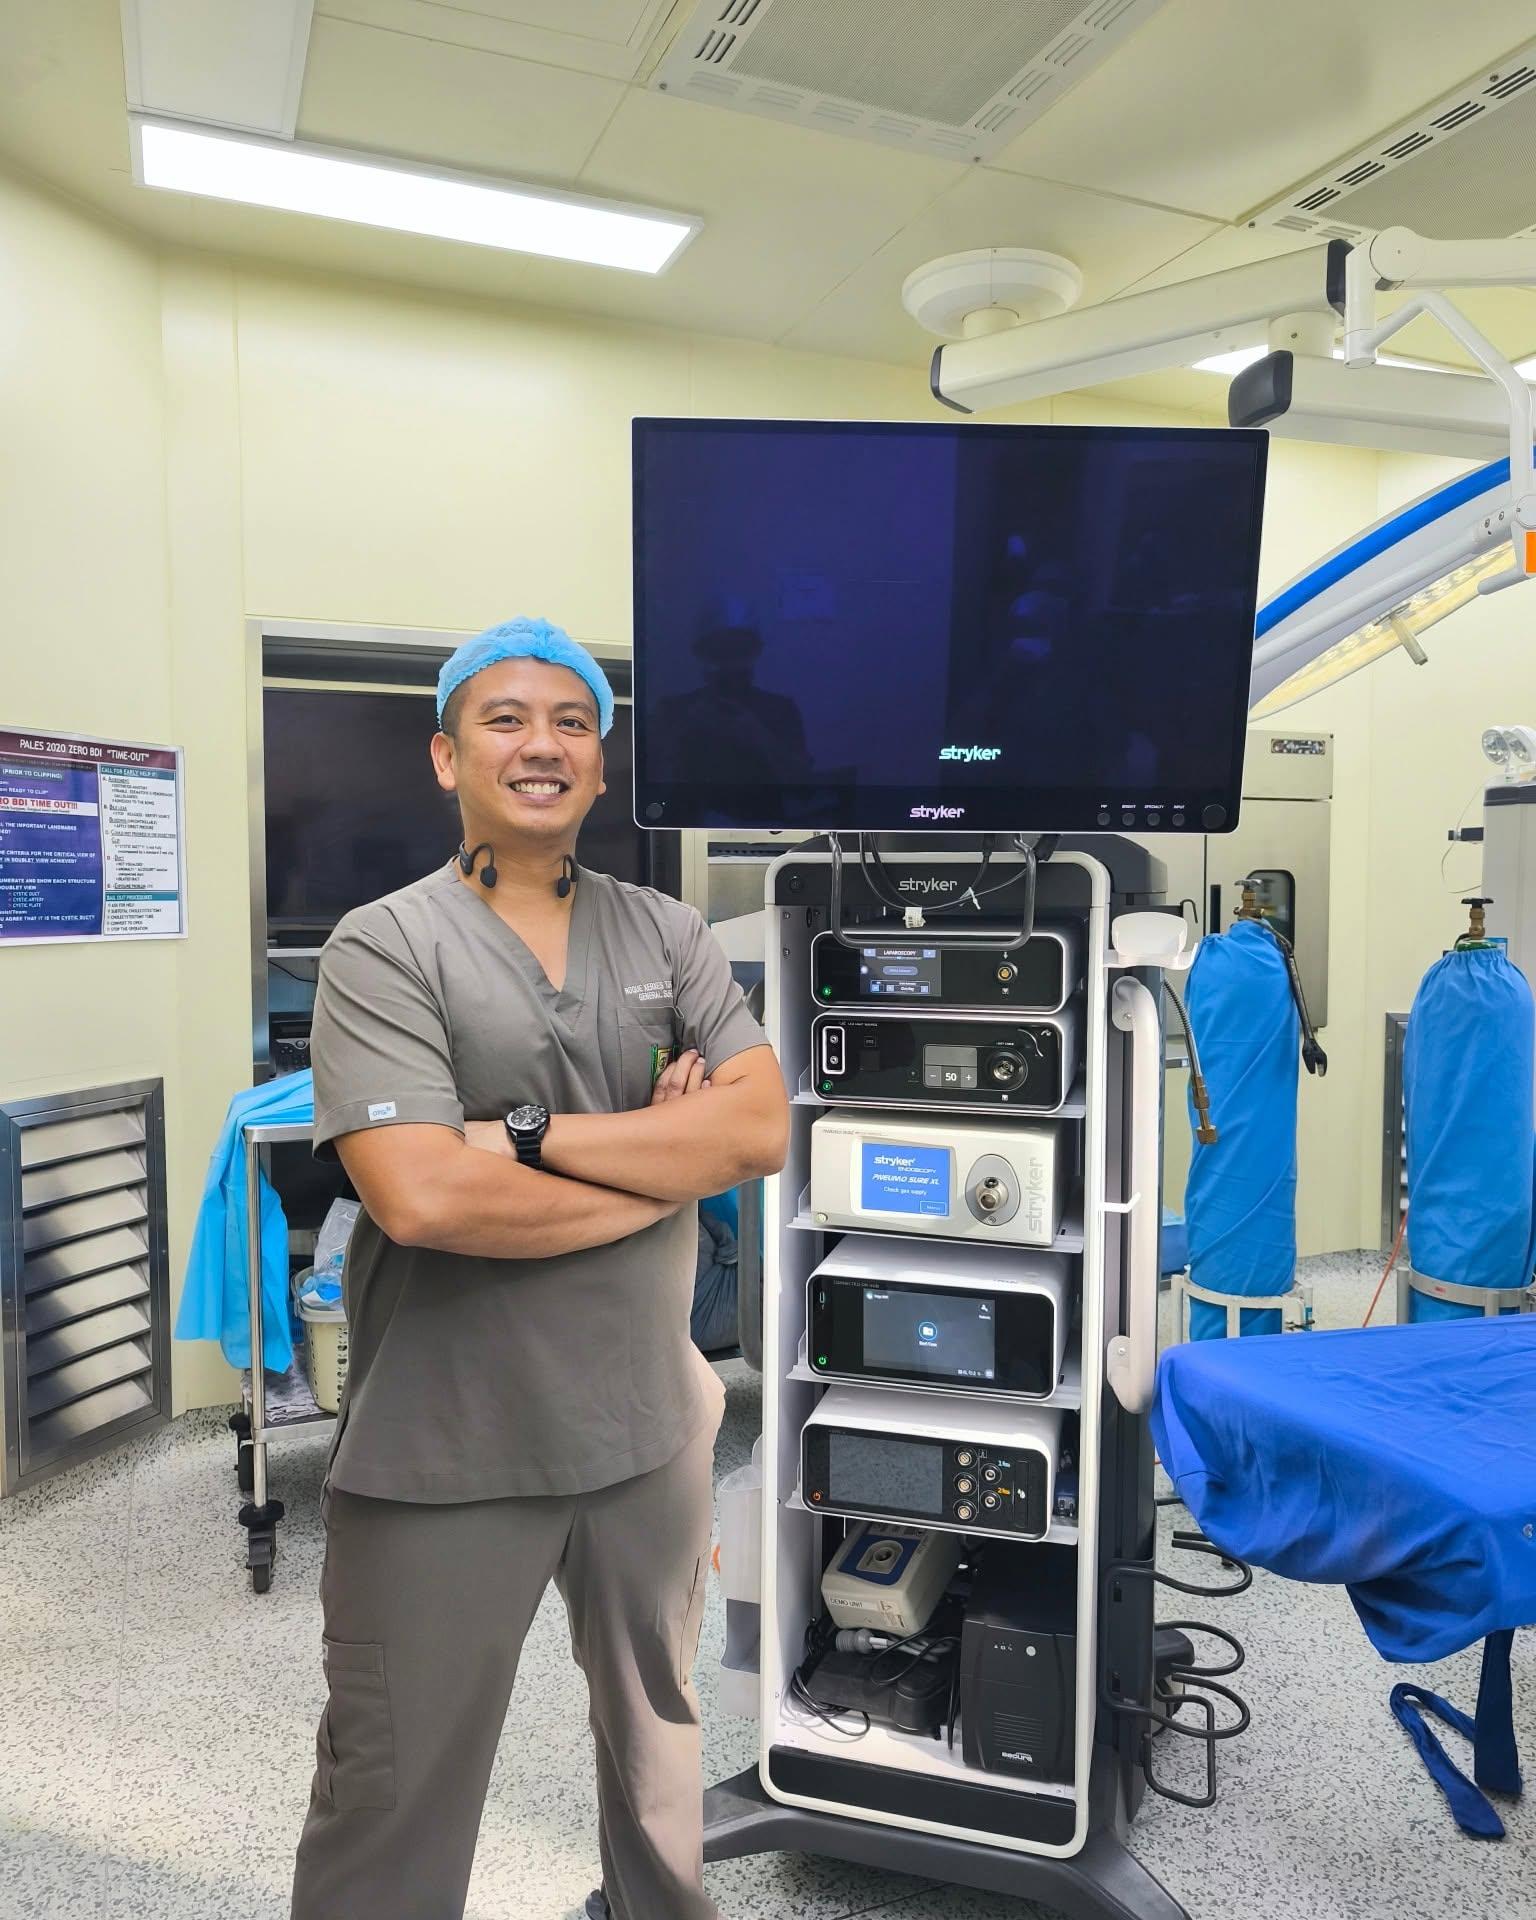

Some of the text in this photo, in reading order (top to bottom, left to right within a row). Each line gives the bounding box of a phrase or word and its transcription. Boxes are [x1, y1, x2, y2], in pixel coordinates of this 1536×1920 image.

[20, 739, 149, 762] PALES 2020 ZERO BDI "TIME-OUT"
[939, 745, 1001, 762] stryker
[12, 798, 28, 806] BDI
[30, 799, 52, 807] TIME
[54, 801, 78, 810] OUT!!!
[910, 805, 965, 820] stryker
[898, 877, 958, 893] stryker
[945, 1072, 957, 1082] 50
[873, 1155, 914, 1167] stryker
[897, 1166, 936, 1174] ENDOSCOPY
[871, 1173, 907, 1182] PNEUMO
[907, 1175, 929, 1185] SURE
[1024, 1158, 1043, 1234] stryker
